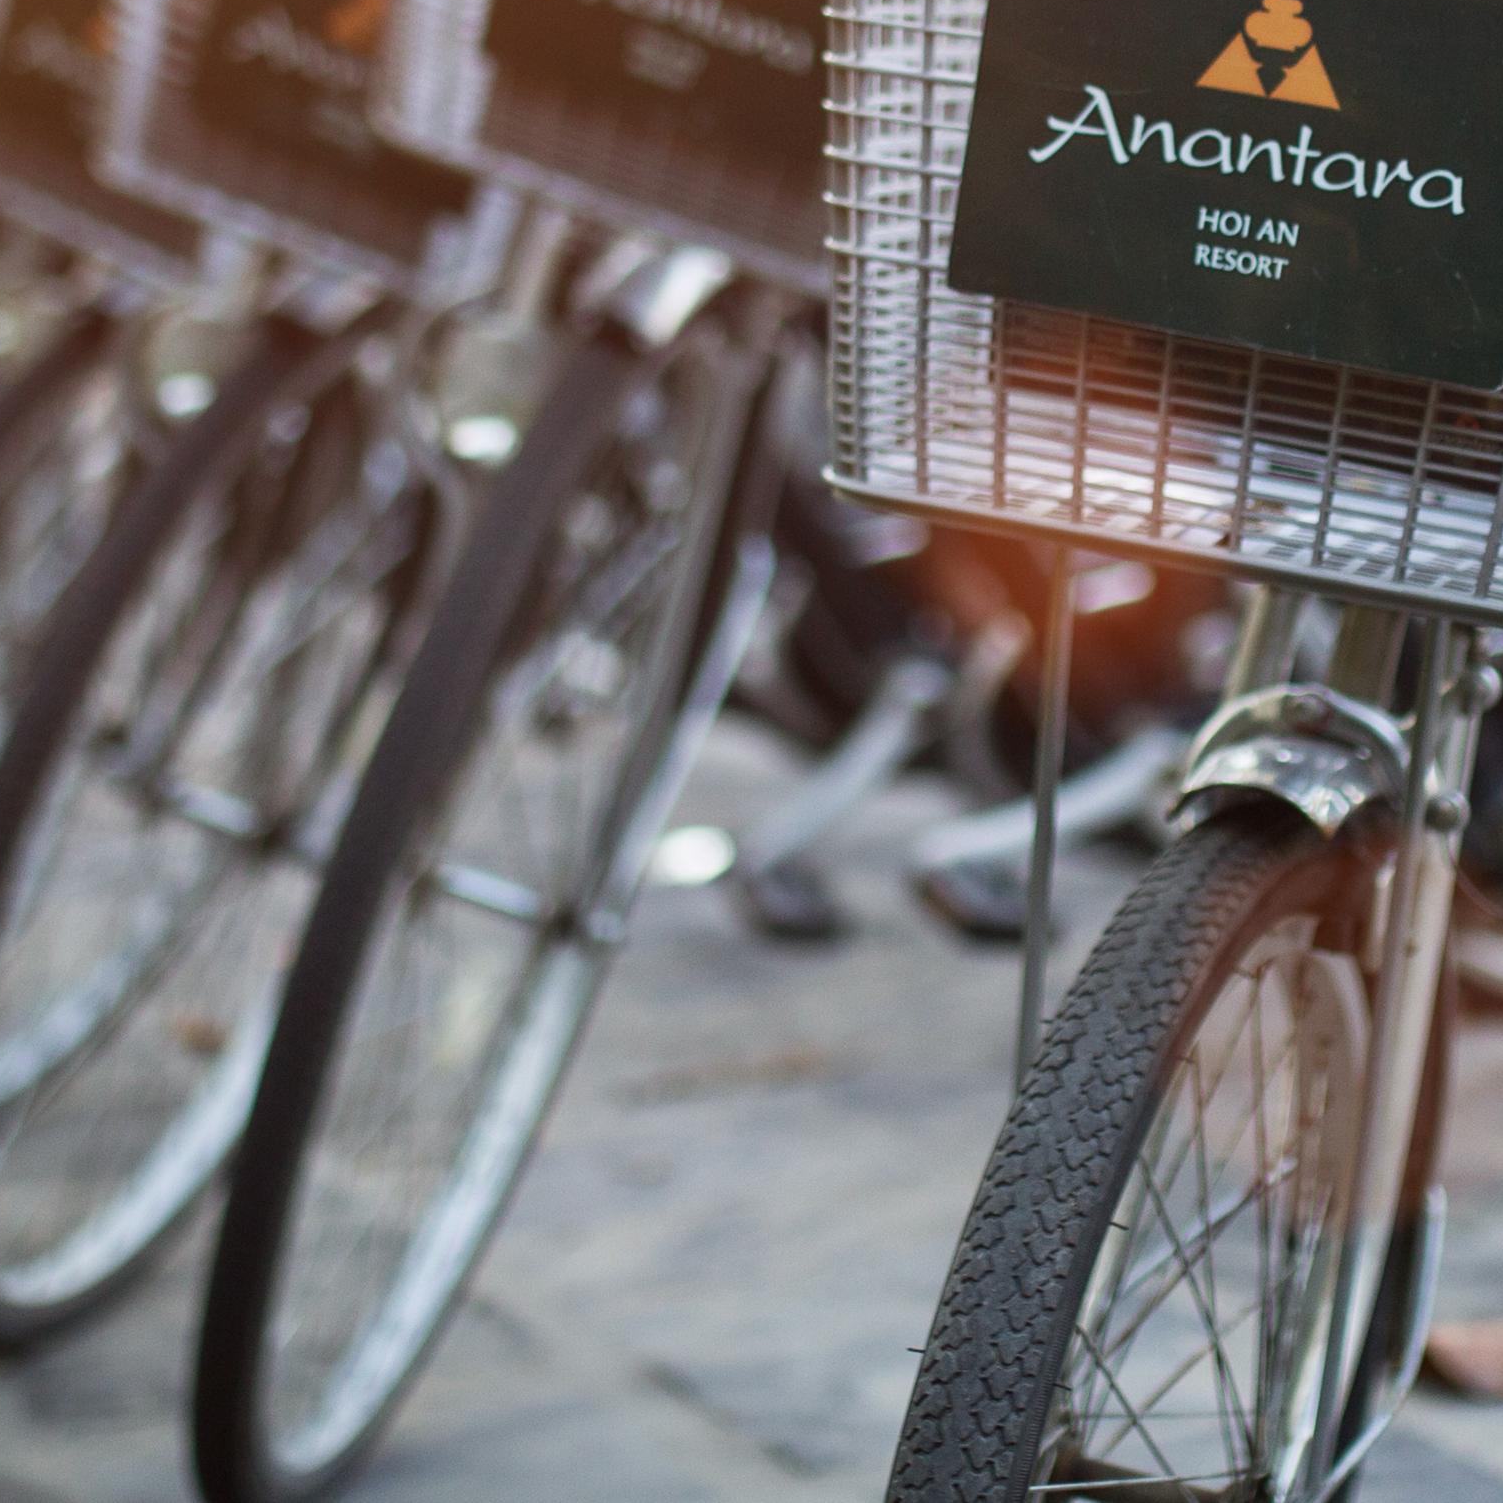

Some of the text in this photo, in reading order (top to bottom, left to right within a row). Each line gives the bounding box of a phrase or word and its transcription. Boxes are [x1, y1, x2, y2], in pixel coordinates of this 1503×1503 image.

[1028, 84, 1466, 215] Anantara
[1197, 207, 1300, 248] HOI AN
[1194, 243, 1289, 280] RESORT
